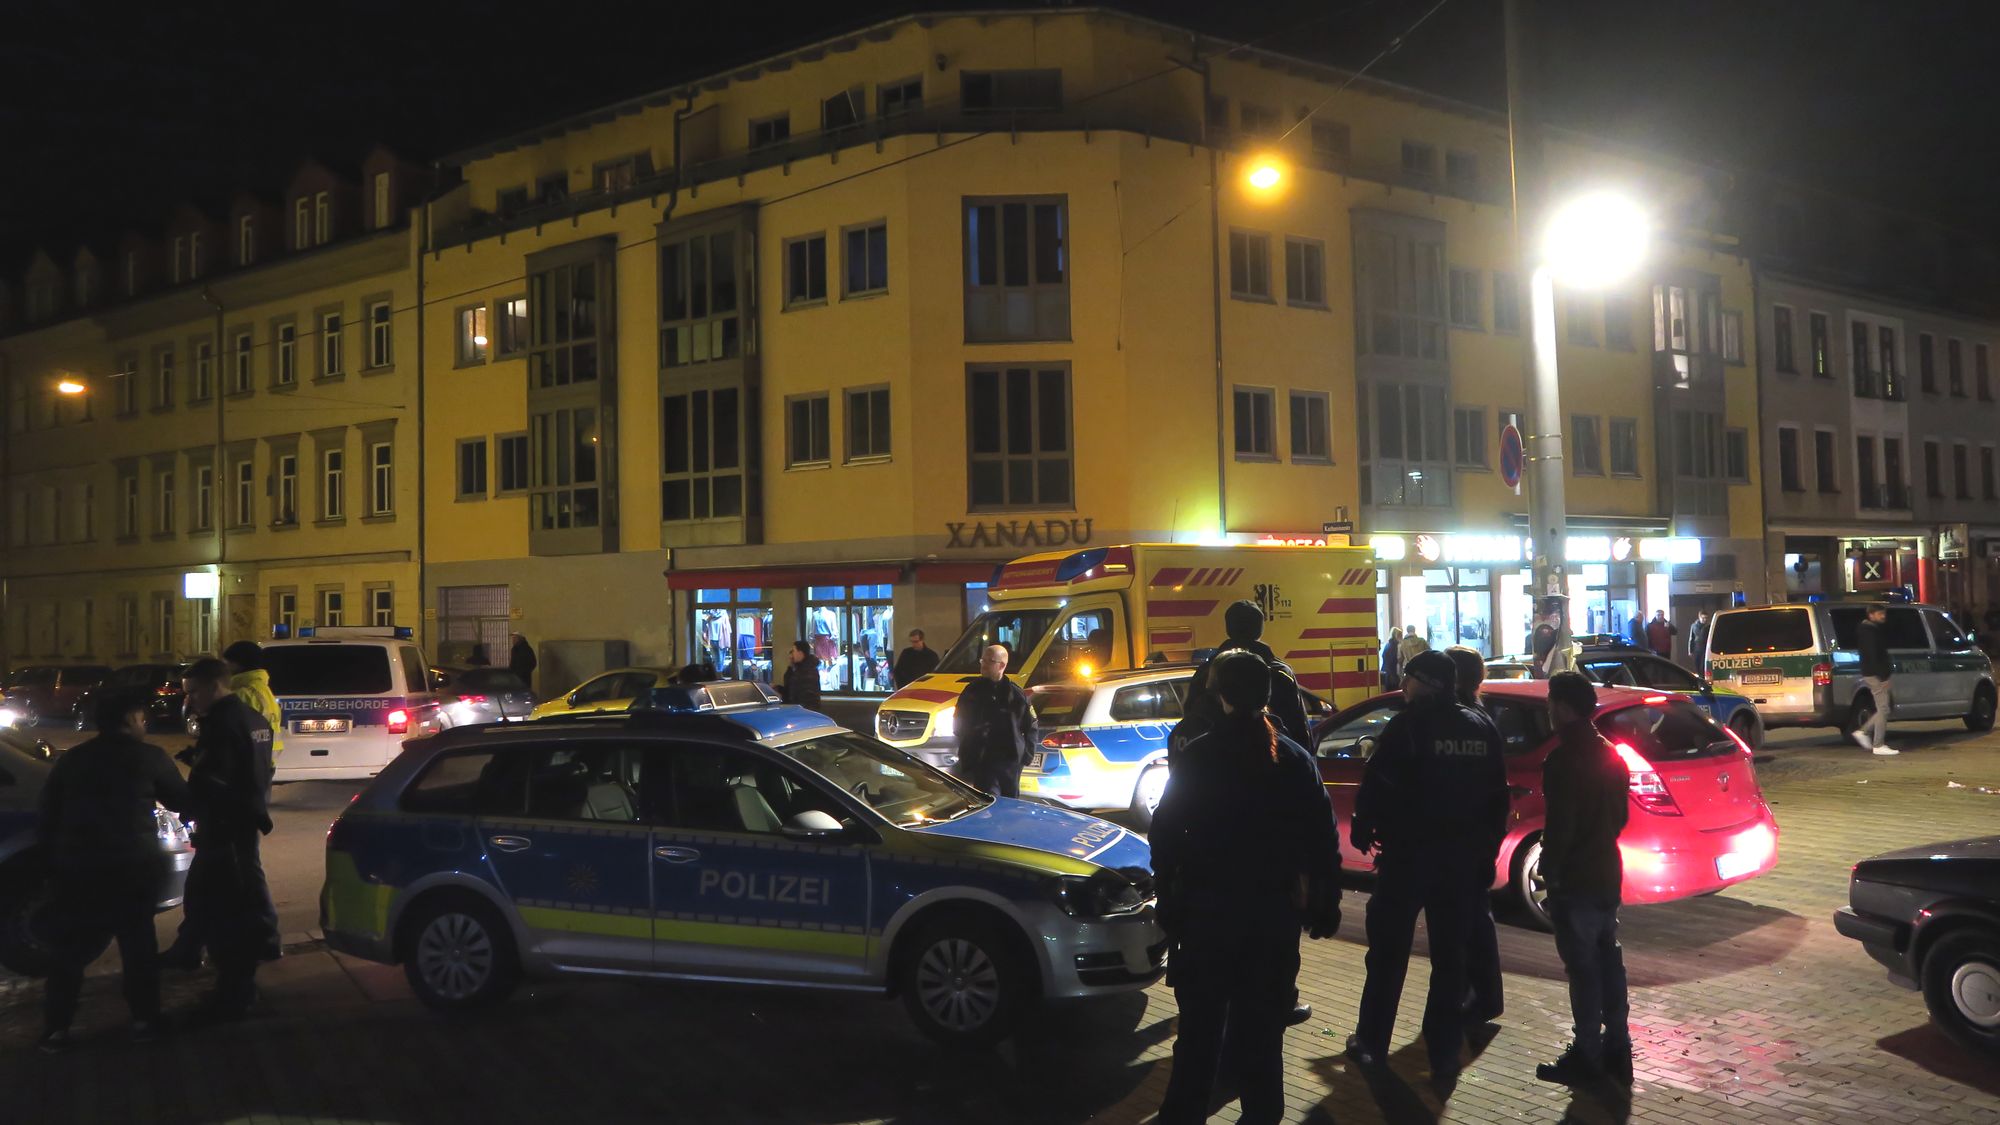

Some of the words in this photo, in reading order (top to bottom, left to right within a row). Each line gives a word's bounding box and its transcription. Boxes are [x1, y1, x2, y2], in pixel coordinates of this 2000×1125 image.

[946, 519, 1092, 548] XANADU
[1281, 600, 1292, 608] 112
[1712, 659, 1752, 669] POLIZEI
[1434, 739, 1488, 757] POLIZEI
[698, 869, 831, 906] POLIZEI
